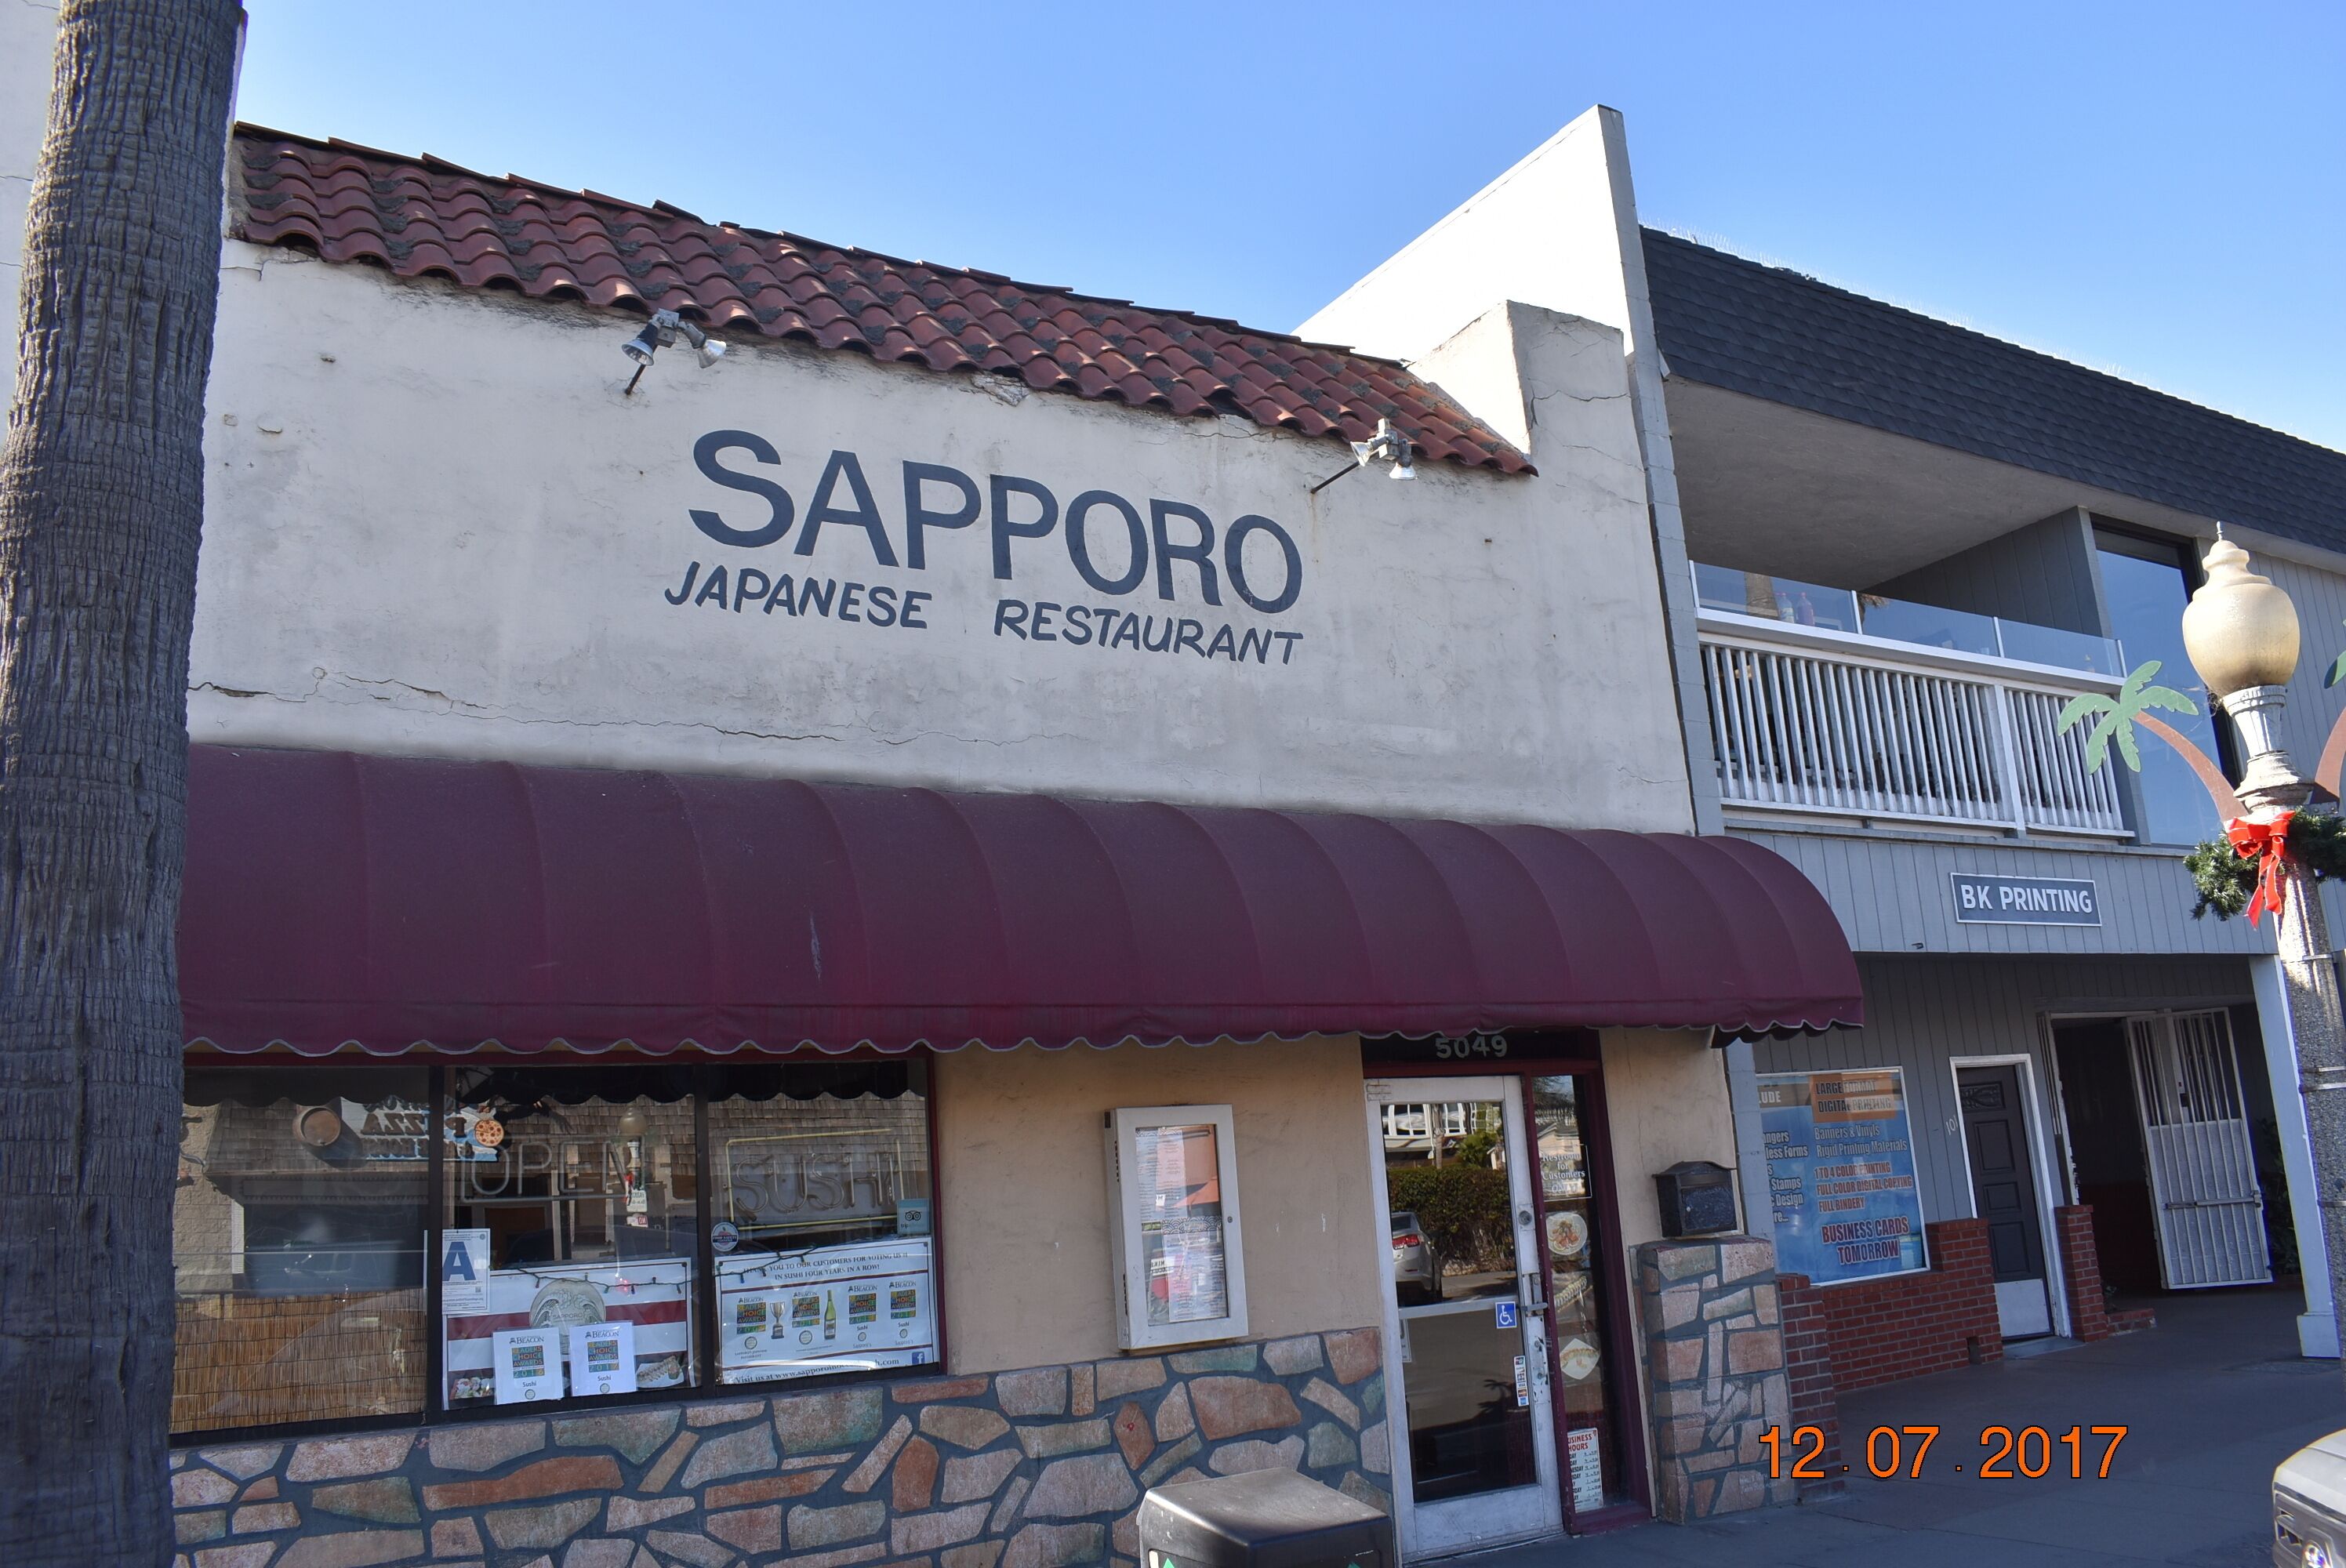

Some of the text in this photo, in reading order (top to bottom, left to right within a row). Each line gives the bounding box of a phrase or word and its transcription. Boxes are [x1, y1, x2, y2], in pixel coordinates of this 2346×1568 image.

[688, 429, 1303, 615] SAPPORO
[664, 561, 1304, 666] JAPANESE RESTAURANT
[1961, 884, 2093, 914] BK PRINTING
[1436, 1035, 1507, 1058] 5049
[1759, 1091, 1781, 1103] UDE
[1816, 1082, 1843, 1094] LARGE
[1818, 1099, 1850, 1112] DIGITAL
[1814, 1124, 1880, 1140] Banners & Vinyls
[1945, 1115, 1959, 1135] 101
[1784, 1145, 1808, 1158] Forms
[1817, 1139, 1908, 1159] Rigid Printing Materials
[471, 1141, 632, 1195] OPEN
[1542, 1171, 1585, 1180] Customers
[1820, 1167, 1829, 1178] TO
[1836, 1165, 1857, 1177] COLOR
[1858, 1163, 1890, 1176] PRINTING
[735, 1152, 895, 1214] SUSHI
[1770, 1177, 1801, 1191] Stamps
[1817, 1176, 1913, 1196] FULL COLOR DIGITAL COPYING
[1775, 1193, 1803, 1207] Design
[1818, 1197, 1865, 1213] FULL BINDERY
[1821, 1217, 1909, 1244] BUSINESS CARDS
[442, 1242, 477, 1281] A
[813, 1257, 853, 1266] CUSTOMERS
[868, 1253, 892, 1261] VOTING
[1838, 1240, 1899, 1265] TOMORROW
[1568, 1443, 1589, 1452] HOURS
